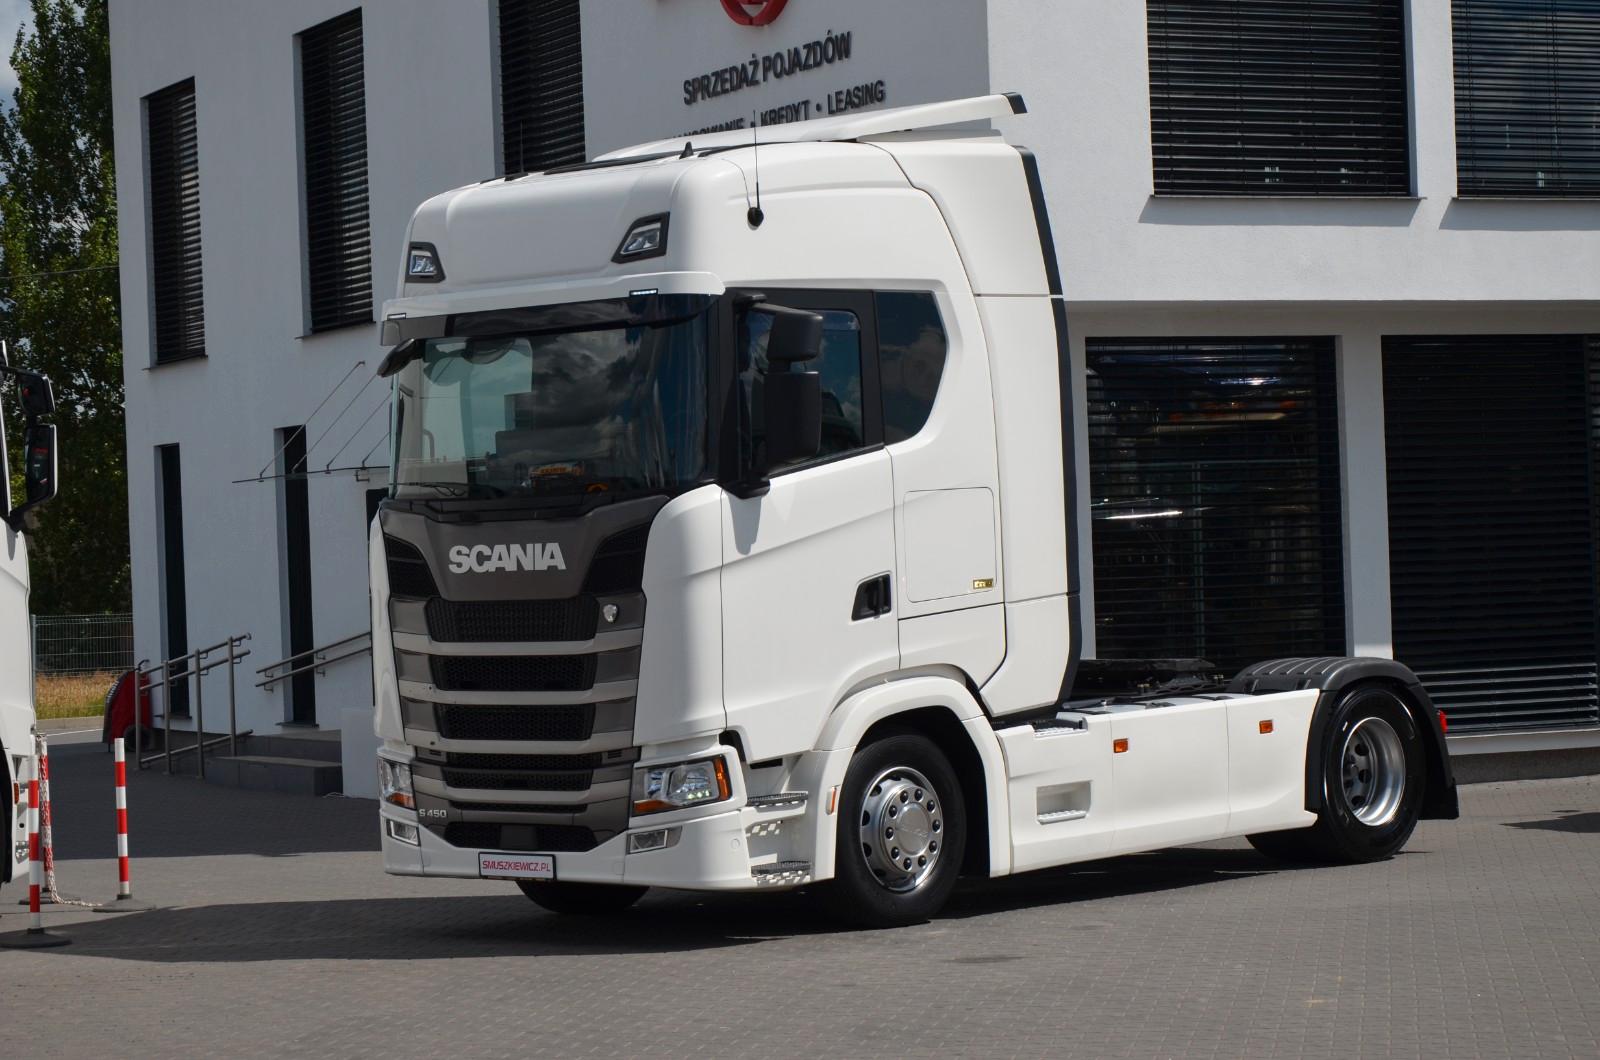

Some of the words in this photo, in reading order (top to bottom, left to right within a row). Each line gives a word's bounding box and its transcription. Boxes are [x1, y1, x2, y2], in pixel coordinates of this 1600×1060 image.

[684, 53, 760, 105] SPRZEDAŻ
[762, 29, 852, 82] POJAZDÓW
[827, 80, 886, 115] LEASING
[448, 542, 566, 574] SCANIA
[419, 809, 425, 817] S
[426, 809, 447, 818] 450
[482, 860, 551, 872] SMUSZKIEWICZ.PL
